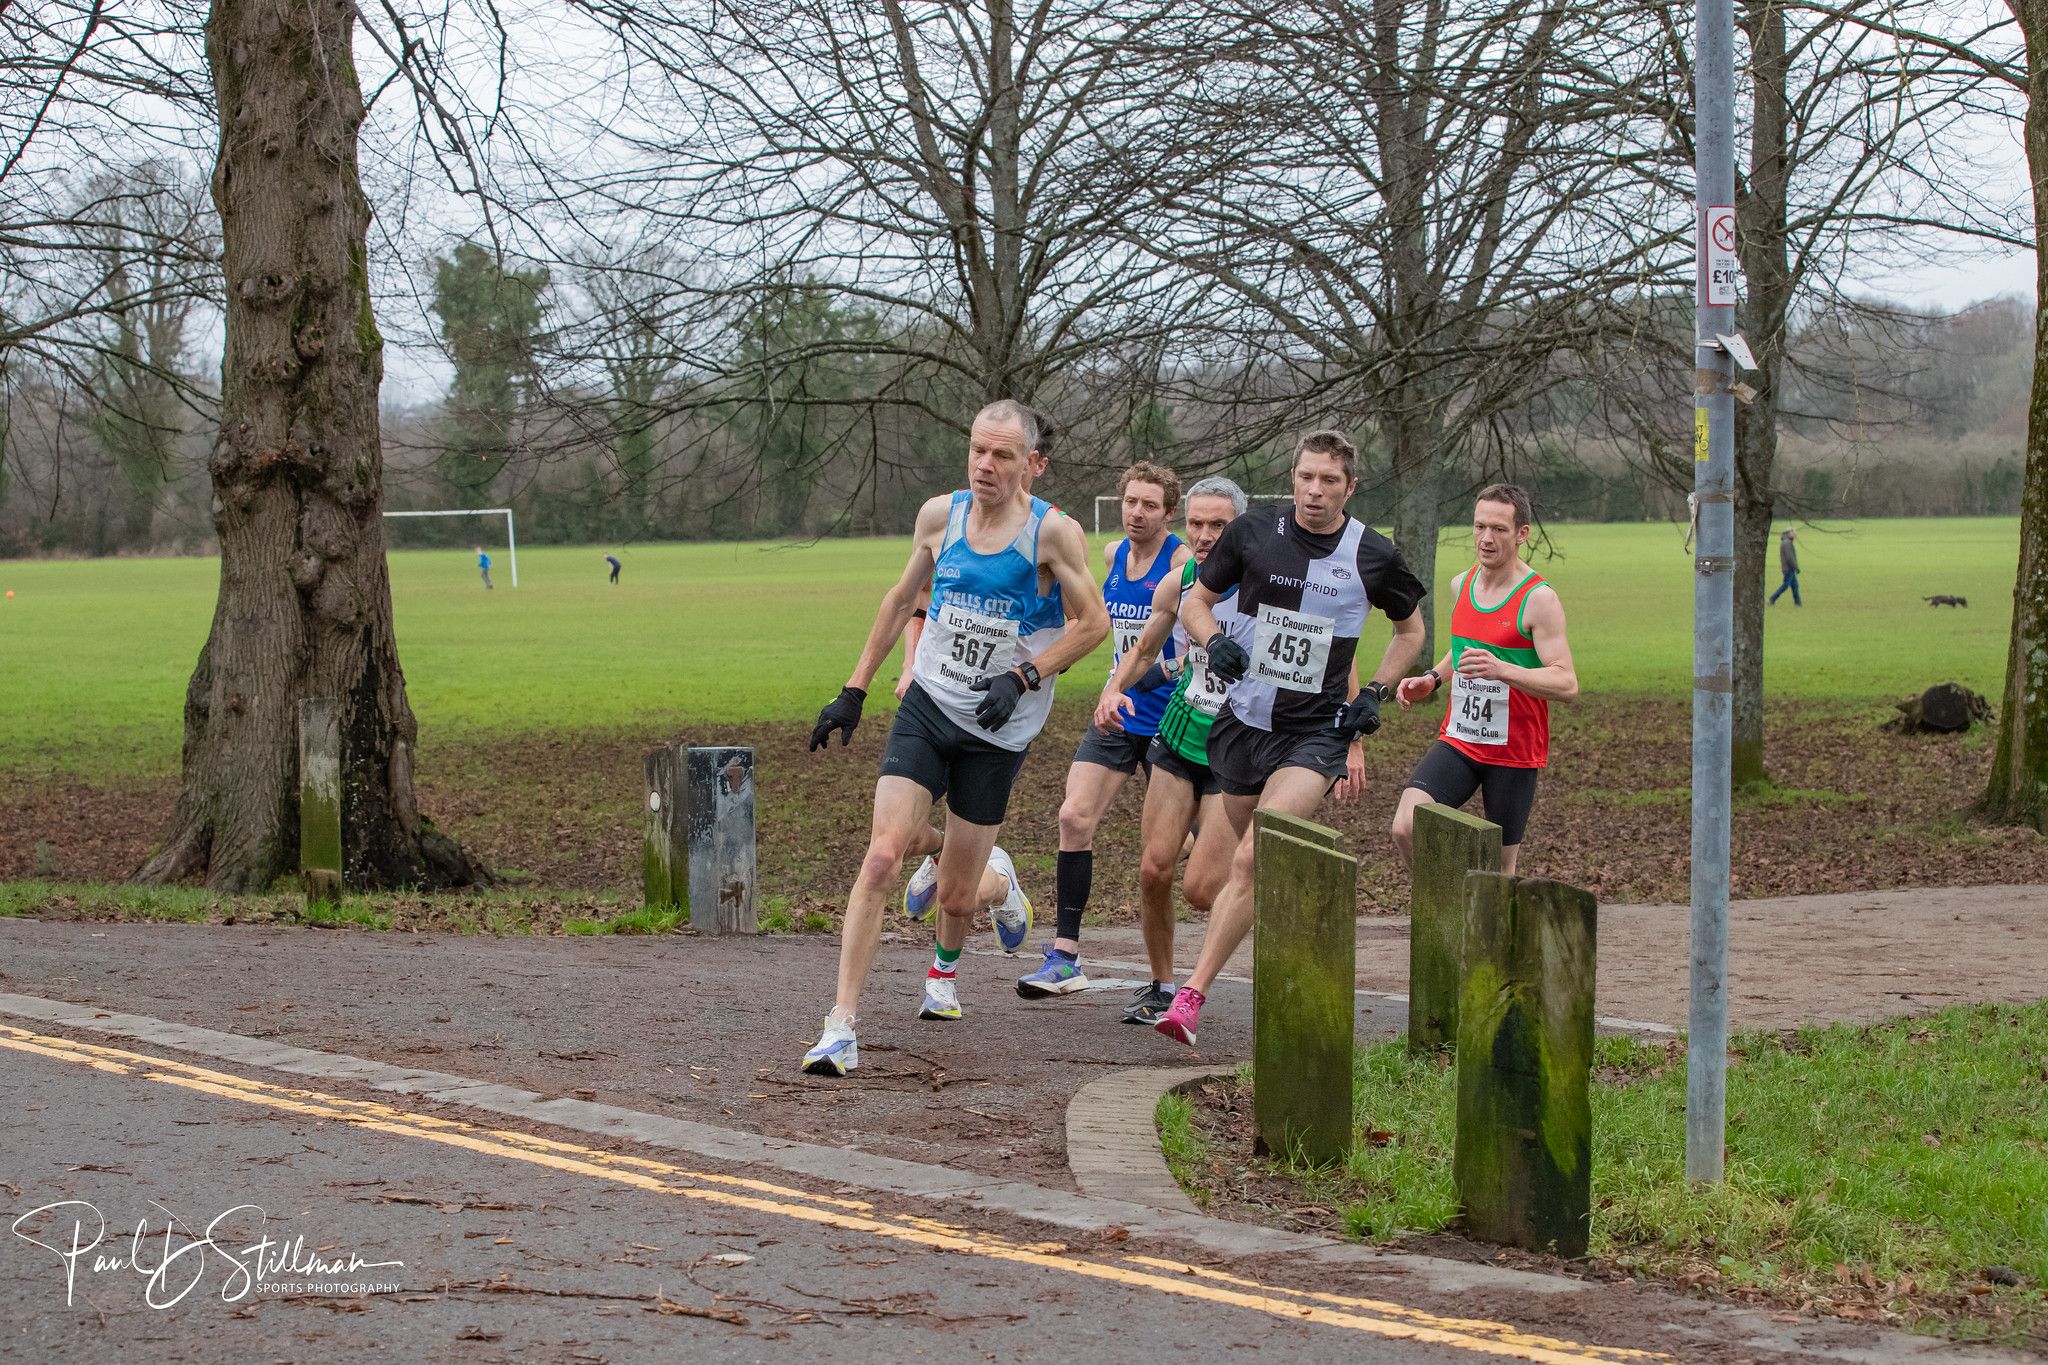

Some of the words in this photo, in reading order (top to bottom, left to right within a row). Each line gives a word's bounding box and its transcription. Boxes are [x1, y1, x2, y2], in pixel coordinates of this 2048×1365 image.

[1269, 574, 1338, 597] PONTYPRIDD
[984, 597, 1014, 613] CITY
[948, 612, 963, 628] LES
[965, 618, 1009, 638] CROUPIERS
[1265, 611, 1280, 626] LES
[1282, 616, 1324, 635] CROUPIERS
[951, 633, 997, 671] 567
[1267, 632, 1312, 668] 453
[940, 663, 973, 685] RUNNING
[1258, 662, 1291, 681] RUNNING
[1292, 670, 1313, 685] CLUB
[1458, 678, 1468, 689] LES
[1468, 680, 1501, 694] CROUPIERS
[1461, 694, 1493, 723] 454
[1456, 722, 1480, 737] RUNNING
[1481, 727, 1499, 738] CLUB
